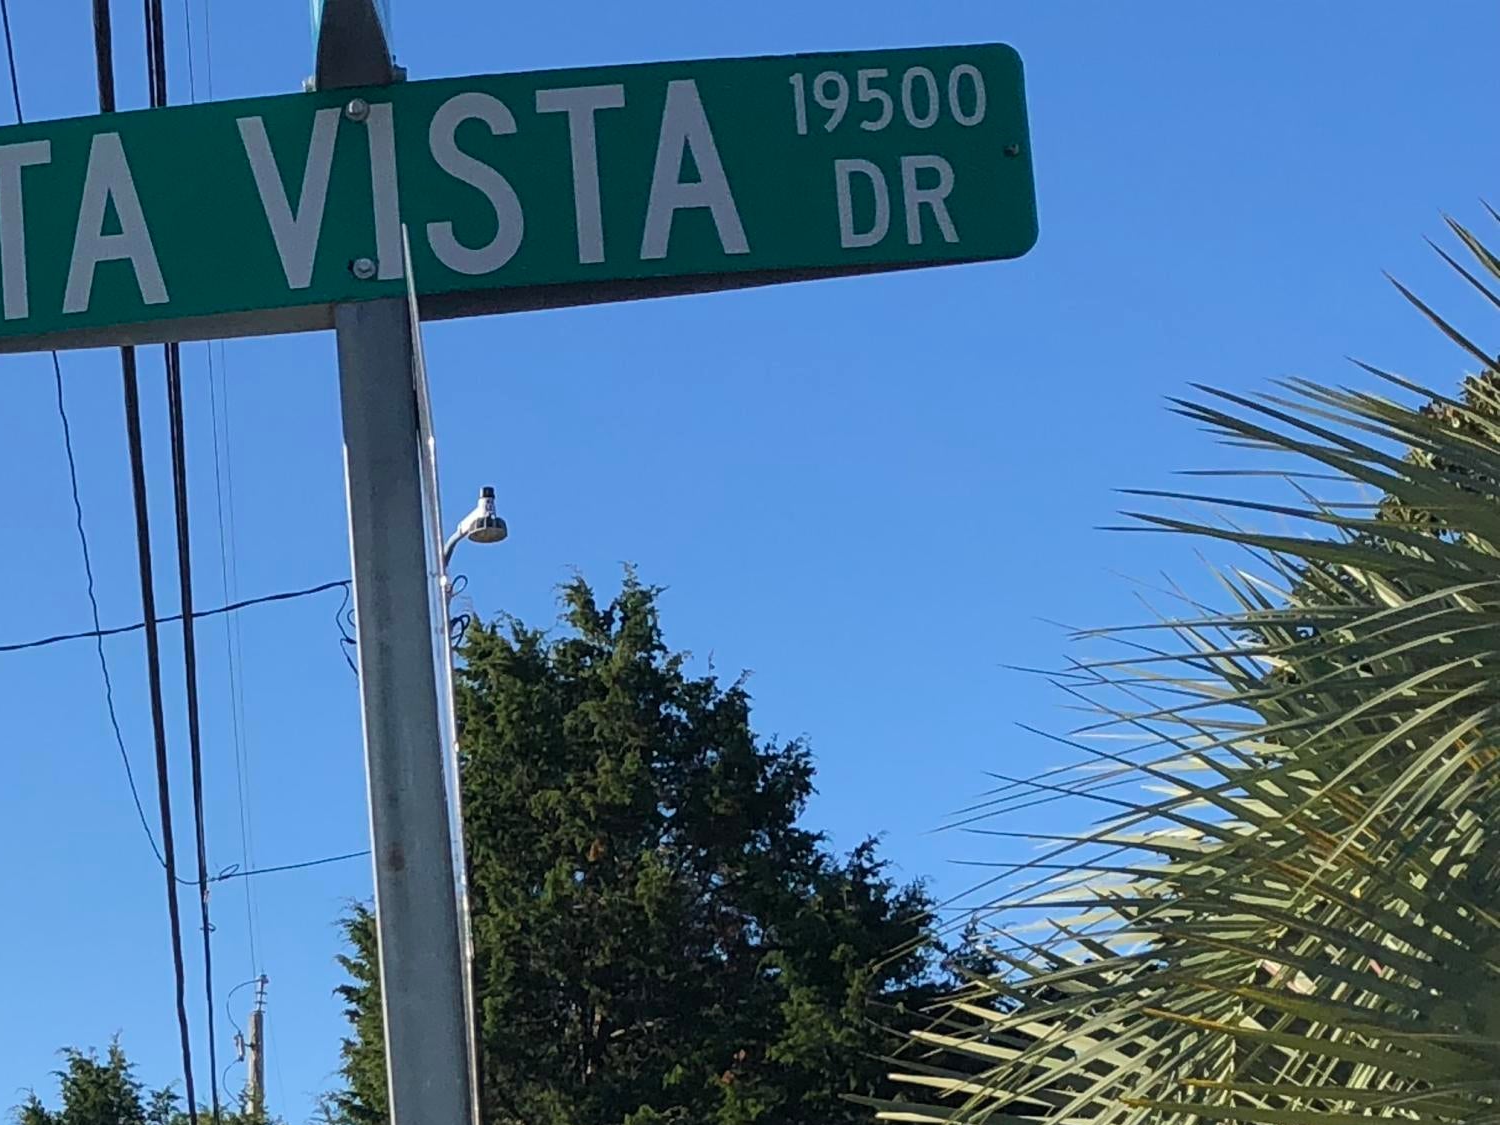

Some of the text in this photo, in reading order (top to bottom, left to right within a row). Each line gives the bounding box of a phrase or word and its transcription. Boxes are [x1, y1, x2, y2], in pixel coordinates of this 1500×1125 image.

[789, 63, 987, 135] 19500
[236, 79, 751, 289] VISTA
[834, 155, 960, 248] DR
